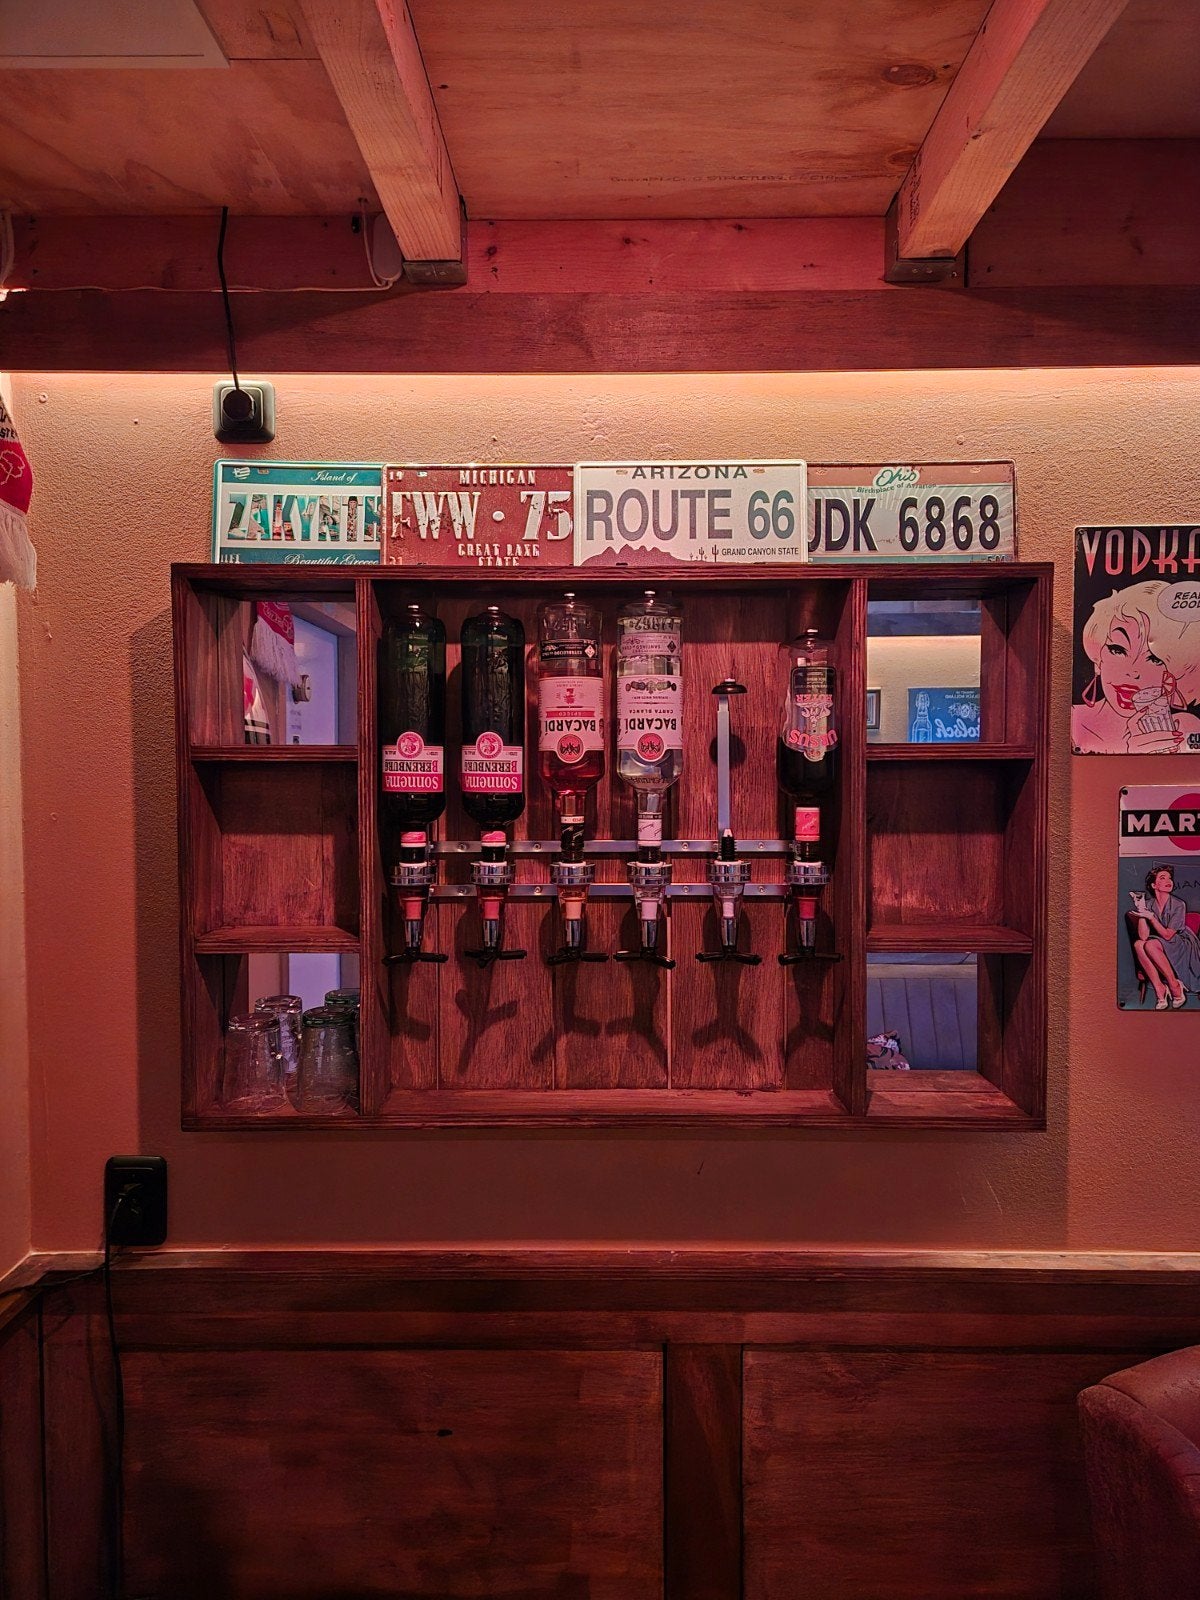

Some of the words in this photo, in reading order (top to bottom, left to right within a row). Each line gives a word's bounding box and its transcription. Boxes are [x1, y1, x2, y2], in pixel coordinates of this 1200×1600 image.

[311, 470, 343, 482] Island
[344, 472, 358, 483] of
[389, 471, 404, 482] 19
[459, 470, 536, 485] MICHIGAN
[632, 465, 748, 480] ARIZONA
[875, 467, 918, 487] Ohio
[856, 485, 894, 495] Birthplace
[391, 491, 481, 540] FWW
[520, 491, 573, 541] 75
[586, 488, 733, 542] ROUTE
[747, 489, 795, 540] 66
[899, 494, 1001, 552] 6868
[283, 552, 337, 565] Beautiful
[340, 551, 378, 565] Greece
[458, 544, 500, 557] GREAT
[721, 547, 746, 556] GRAND
[748, 547, 776, 556] CANYON
[778, 546, 799, 556] STATE
[478, 557, 519, 566] STATE
[1174, 591, 1200, 600] REA
[545, 719, 596, 736] BACARDÍ
[625, 717, 677, 735] BACARDÍ
[788, 729, 838, 748] URSUS
[1128, 813, 1200, 834] MAR
